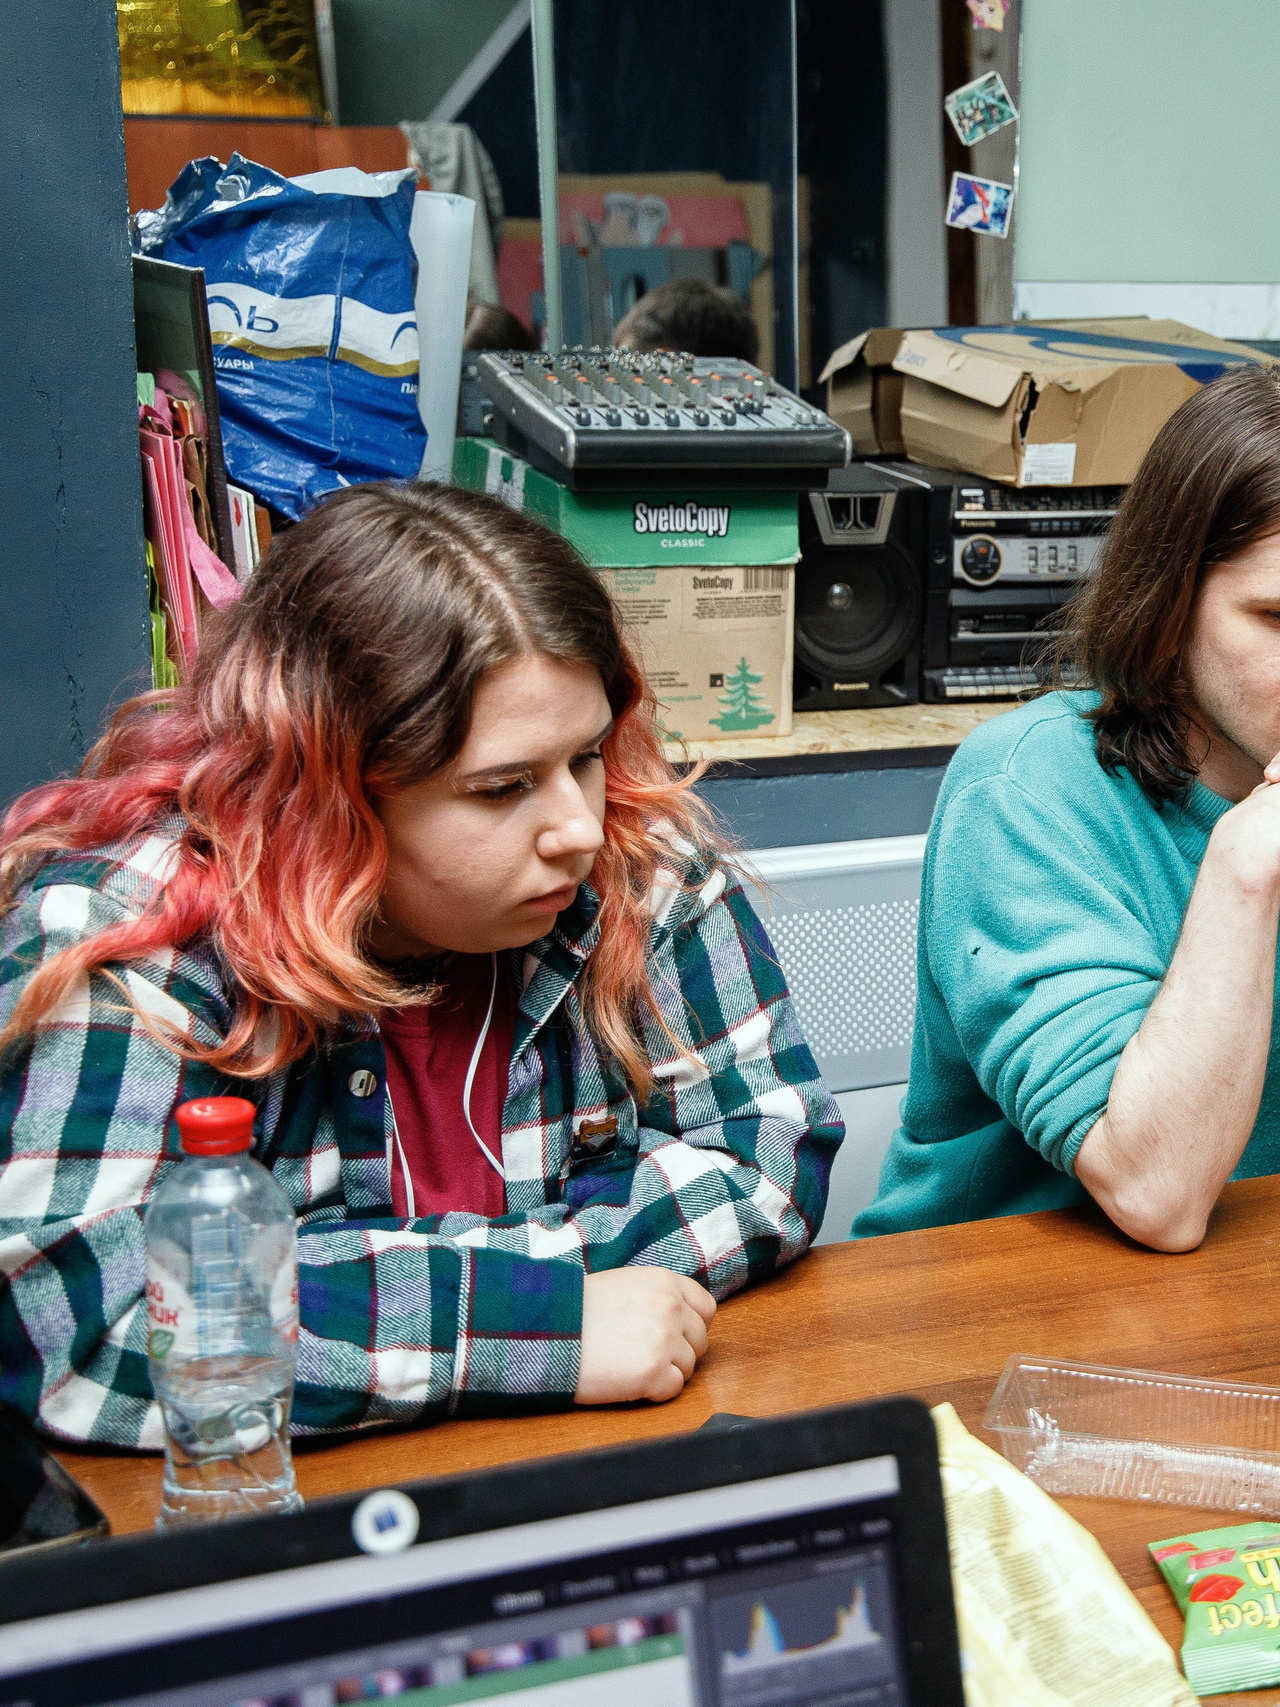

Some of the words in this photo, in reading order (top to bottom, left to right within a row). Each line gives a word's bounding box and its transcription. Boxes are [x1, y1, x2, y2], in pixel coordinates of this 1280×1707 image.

[633, 500, 730, 538] SvetoCopy
[660, 538, 706, 549] CLASSIC
[692, 574, 734, 591] SvetoCopy
